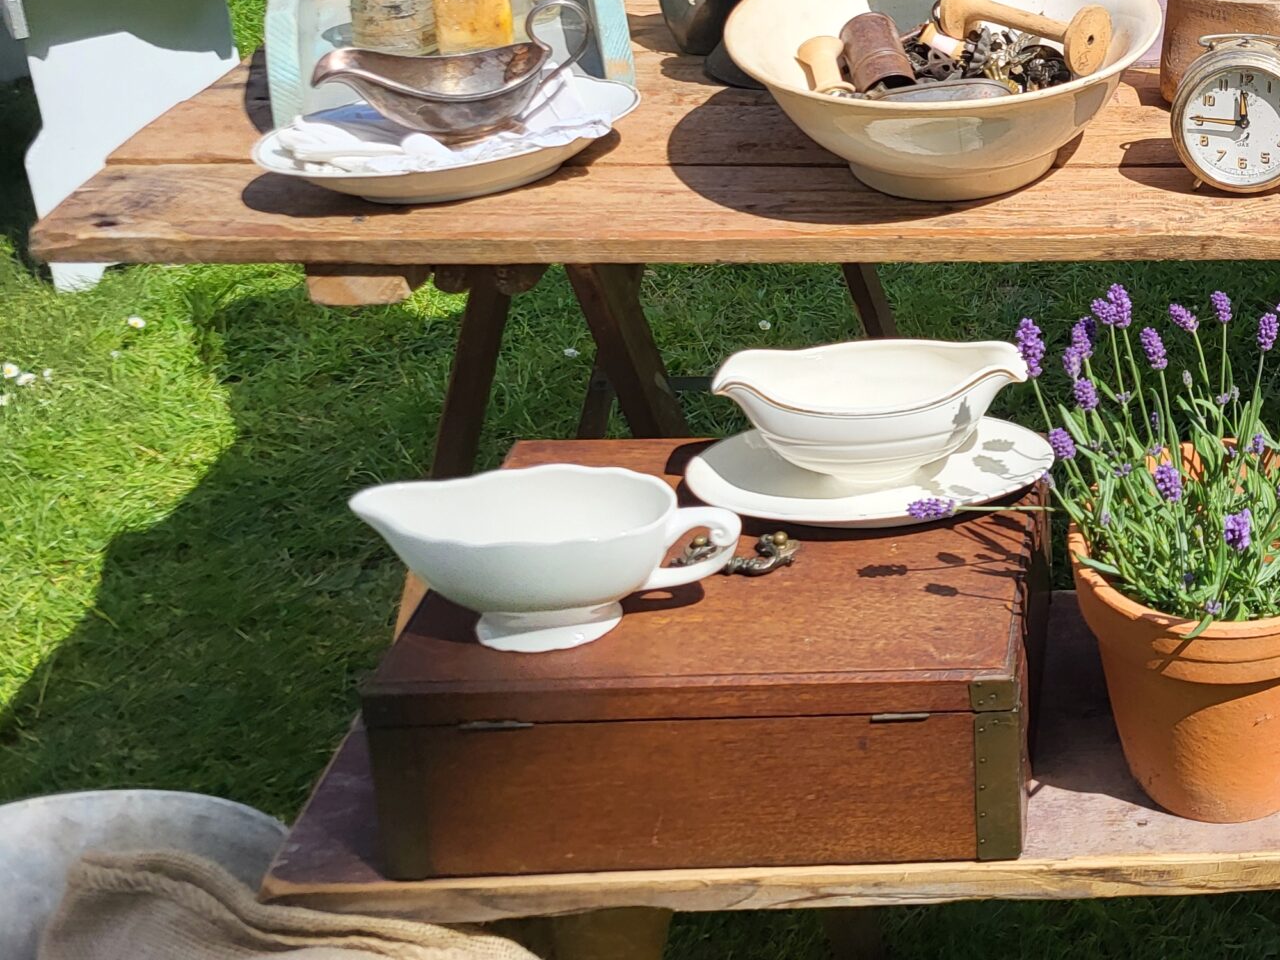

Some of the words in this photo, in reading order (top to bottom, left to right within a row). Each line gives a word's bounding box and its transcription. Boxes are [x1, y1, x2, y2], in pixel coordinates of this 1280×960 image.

[1218, 78, 1229, 91] 11
[1239, 73, 1254, 87] 12
[1267, 80, 1272, 94] 1
[1202, 94, 1216, 107] 10
[1200, 135, 1209, 147] 8
[1216, 149, 1227, 162] 7
[1260, 151, 1270, 164] 5
[1237, 156, 1248, 169] 6
